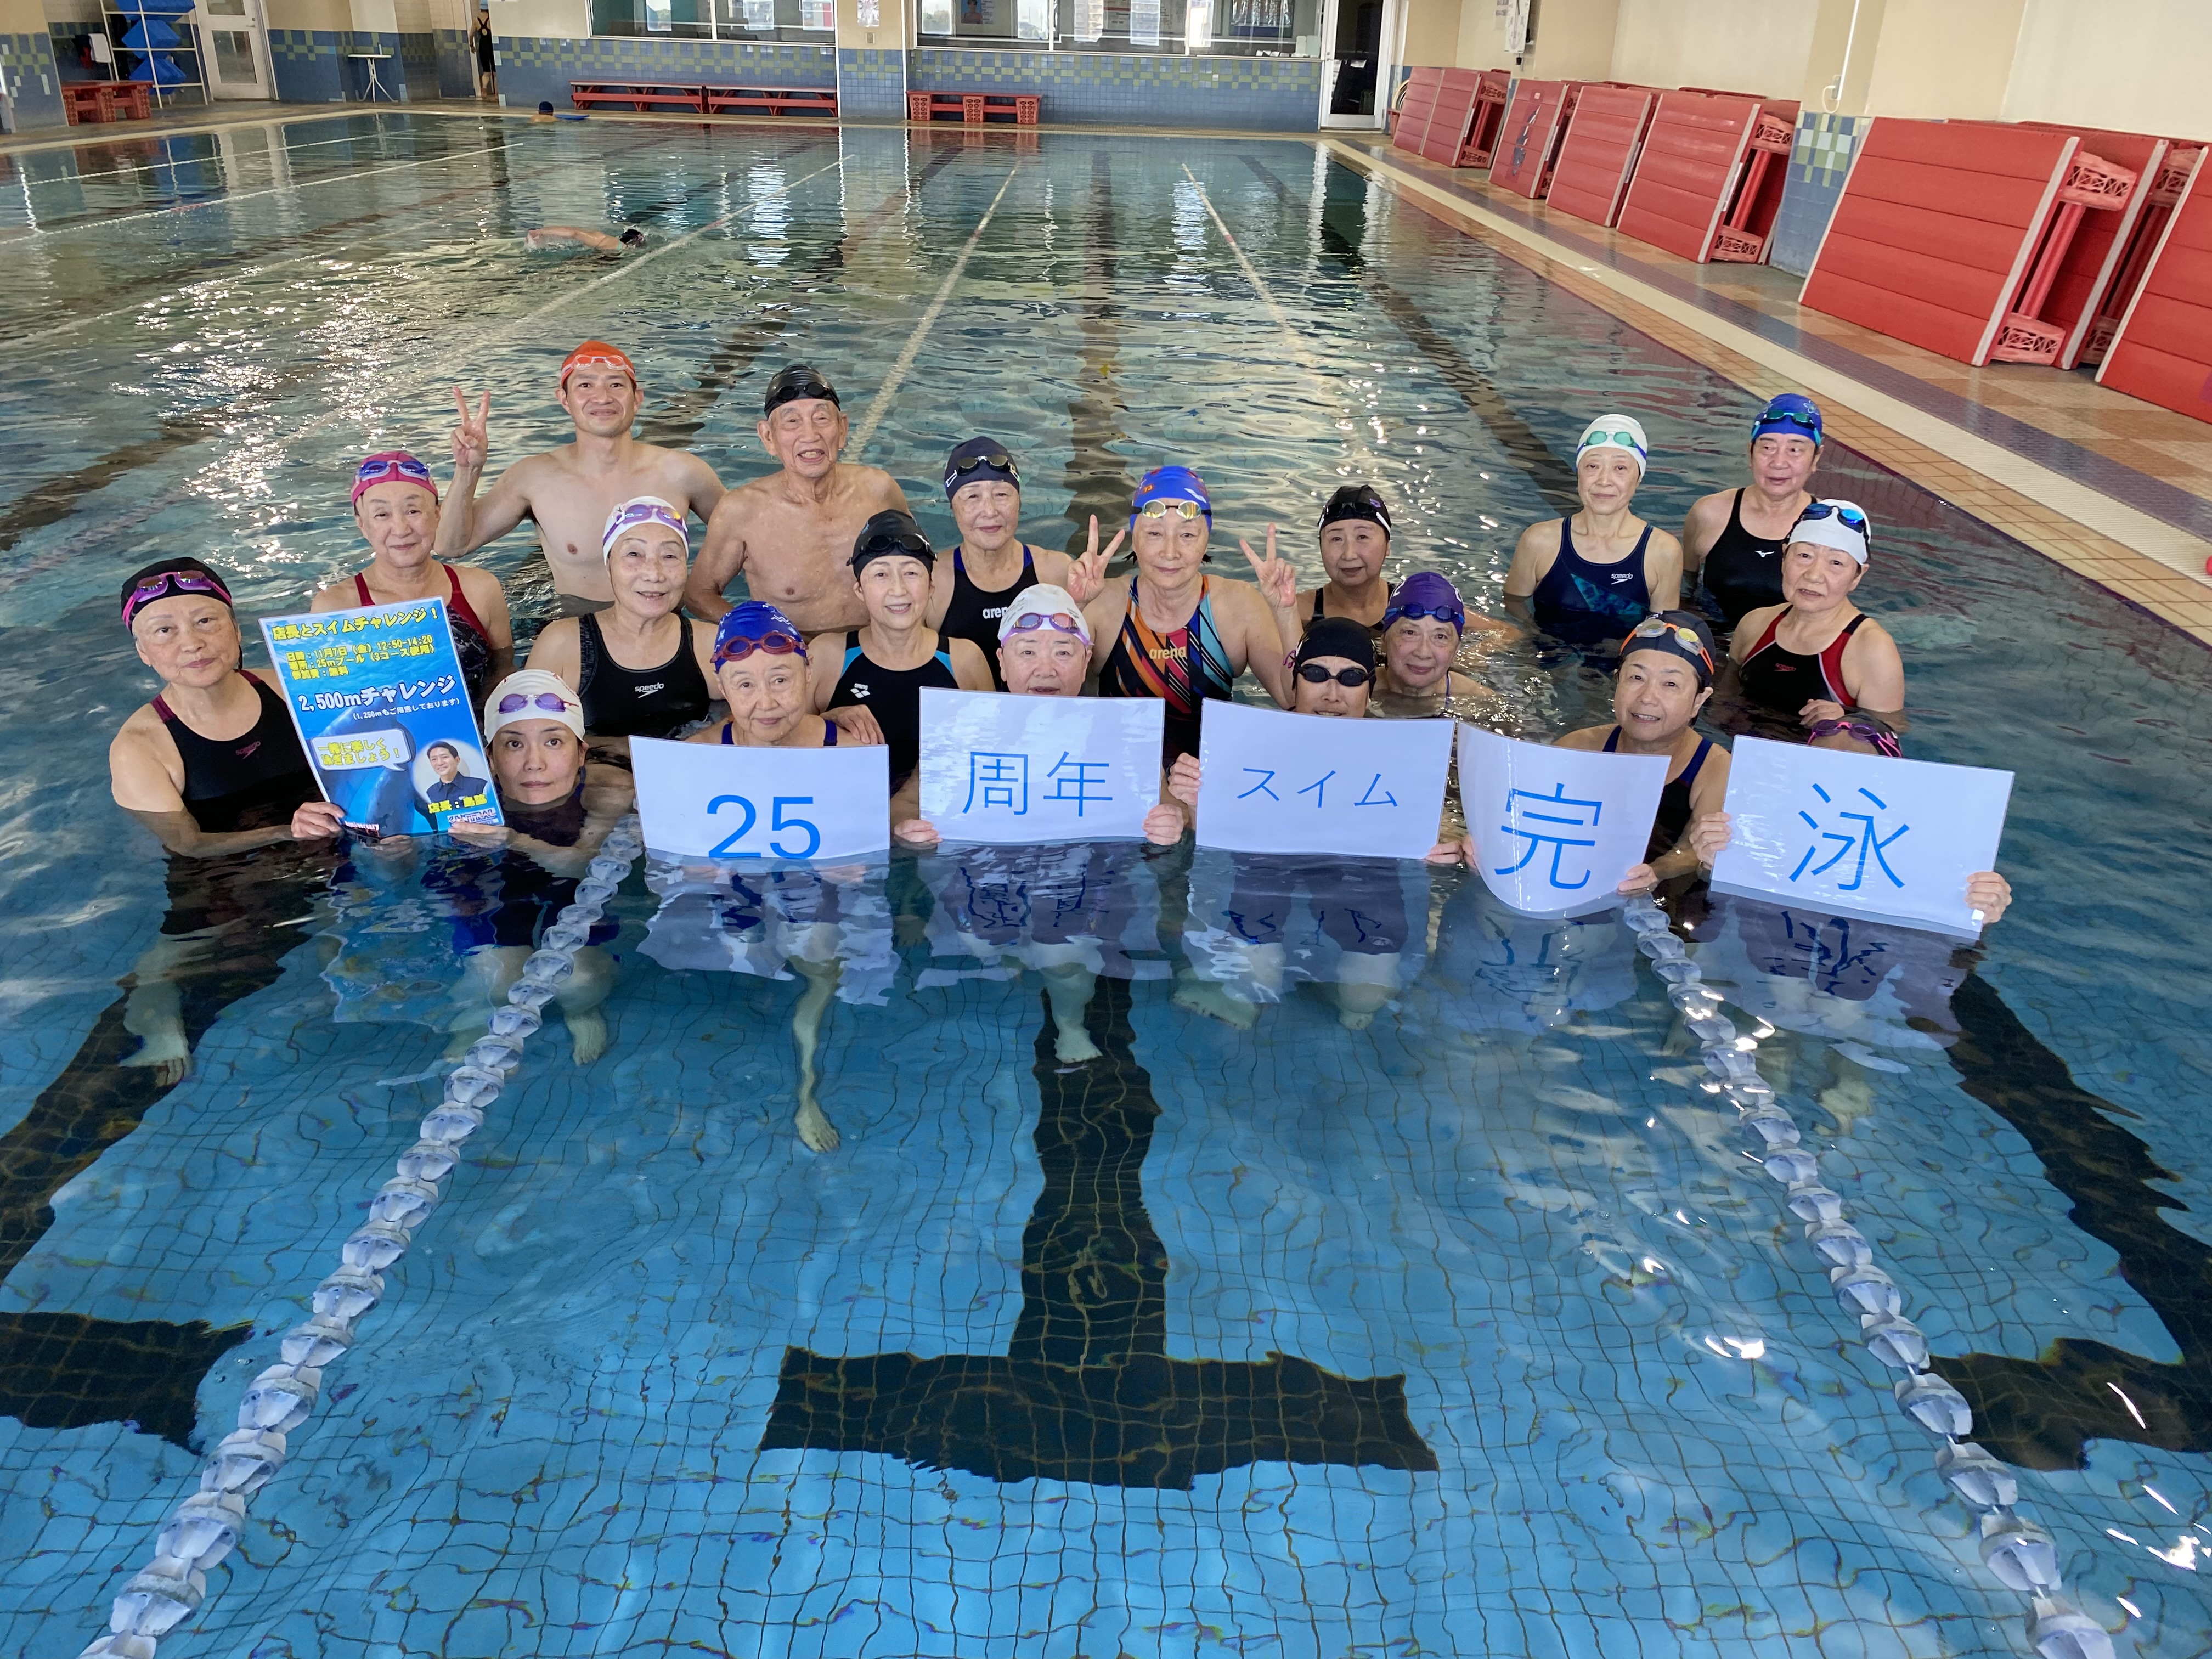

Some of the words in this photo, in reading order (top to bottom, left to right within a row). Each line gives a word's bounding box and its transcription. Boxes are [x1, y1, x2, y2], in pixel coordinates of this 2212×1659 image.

[983, 606, 1009, 619] aren
[1149, 646, 1187, 659] arena
[635, 682, 664, 693] speedo
[962, 751, 1113, 817] 周年
[1236, 768, 1398, 808] スイム
[707, 794, 821, 860] 25
[1494, 782, 1602, 890] 完
[1788, 783, 1910, 891] 泳
